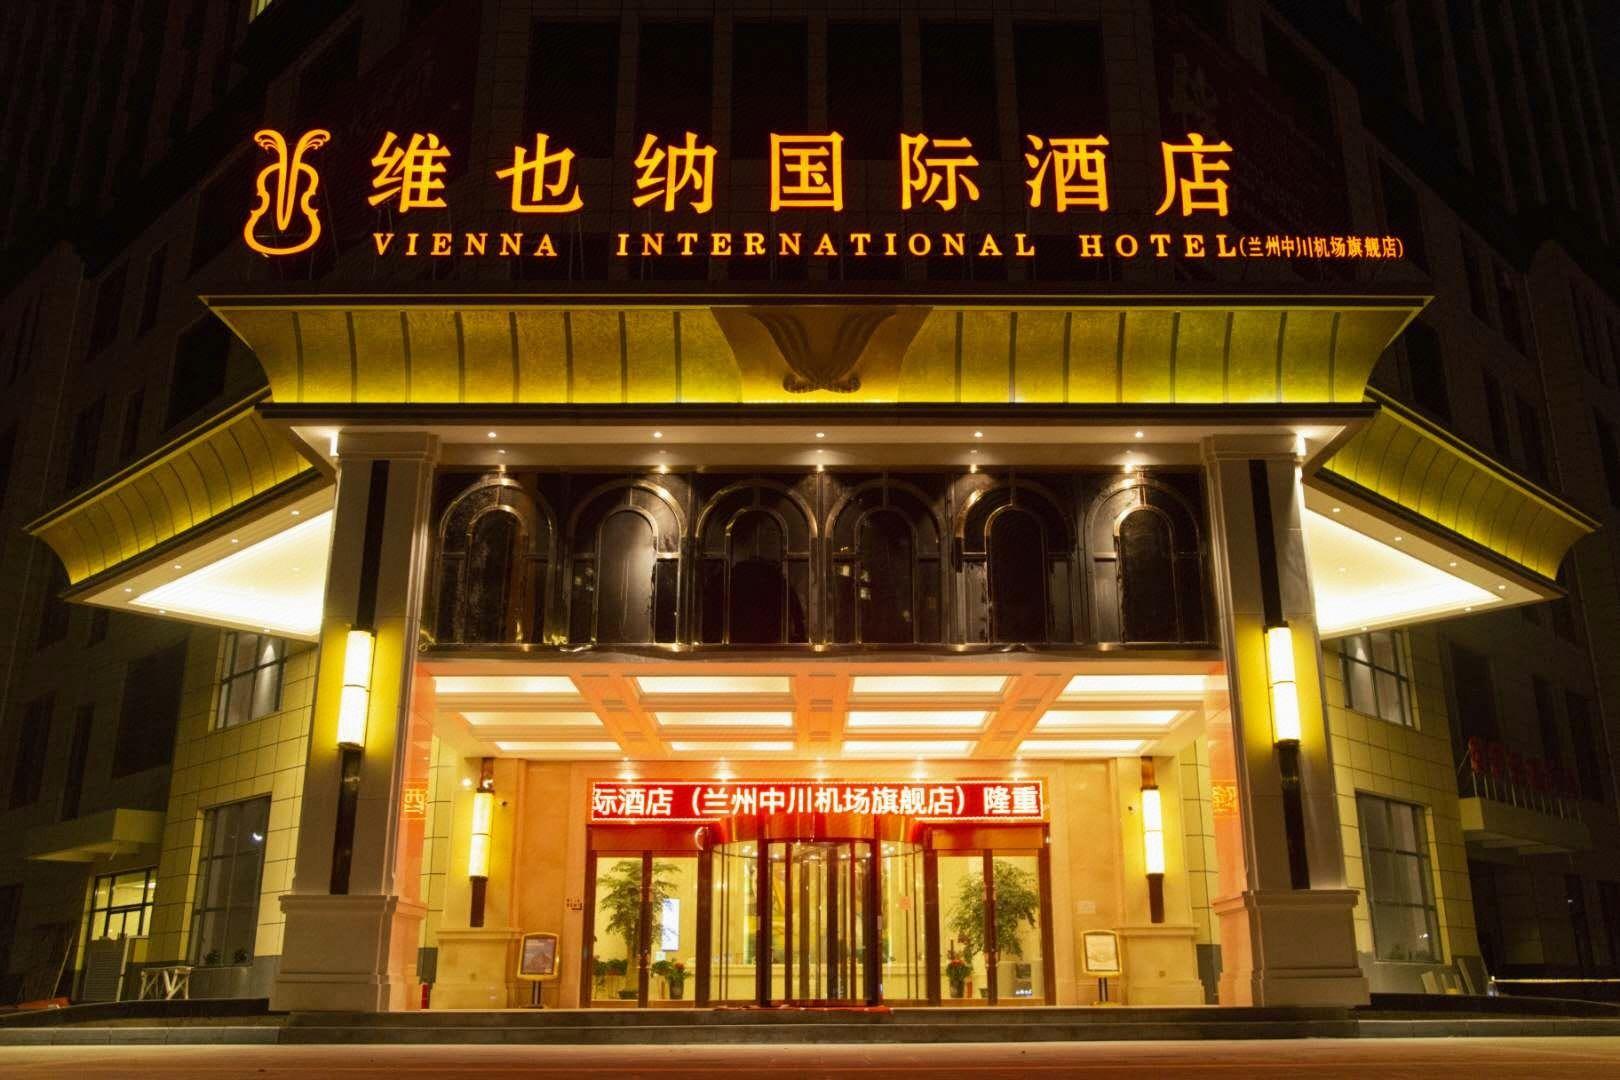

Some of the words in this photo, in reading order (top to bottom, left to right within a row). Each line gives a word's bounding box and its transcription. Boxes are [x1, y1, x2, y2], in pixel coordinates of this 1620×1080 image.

[367, 130, 1234, 217] 维也纳国际酒店
[372, 232, 558, 257] VIENNA
[615, 232, 1035, 258] INTERNATIONAL
[1078, 233, 1237, 258] HOTEL
